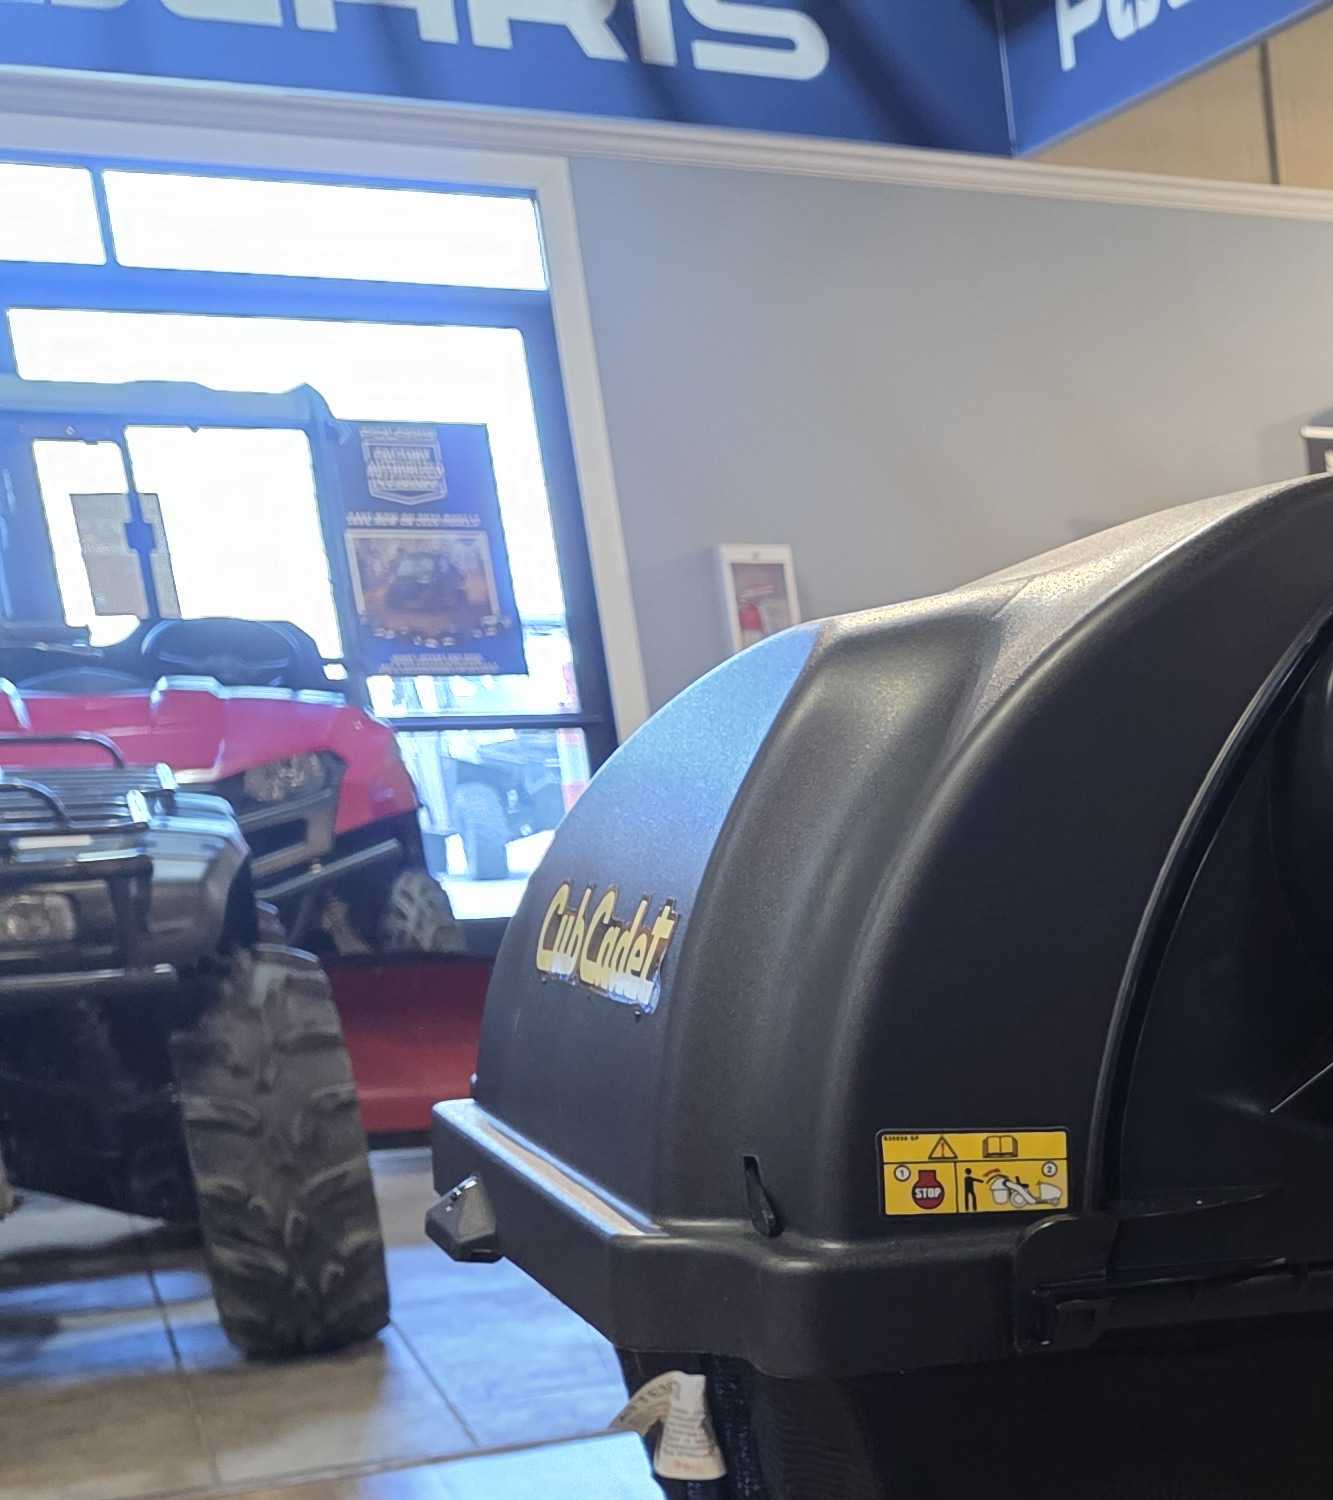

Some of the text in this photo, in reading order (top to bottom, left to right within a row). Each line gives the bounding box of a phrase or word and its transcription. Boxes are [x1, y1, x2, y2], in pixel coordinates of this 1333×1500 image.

[536, 883, 675, 1007] Cub Cadet
[914, 1186, 943, 1199] STOP
